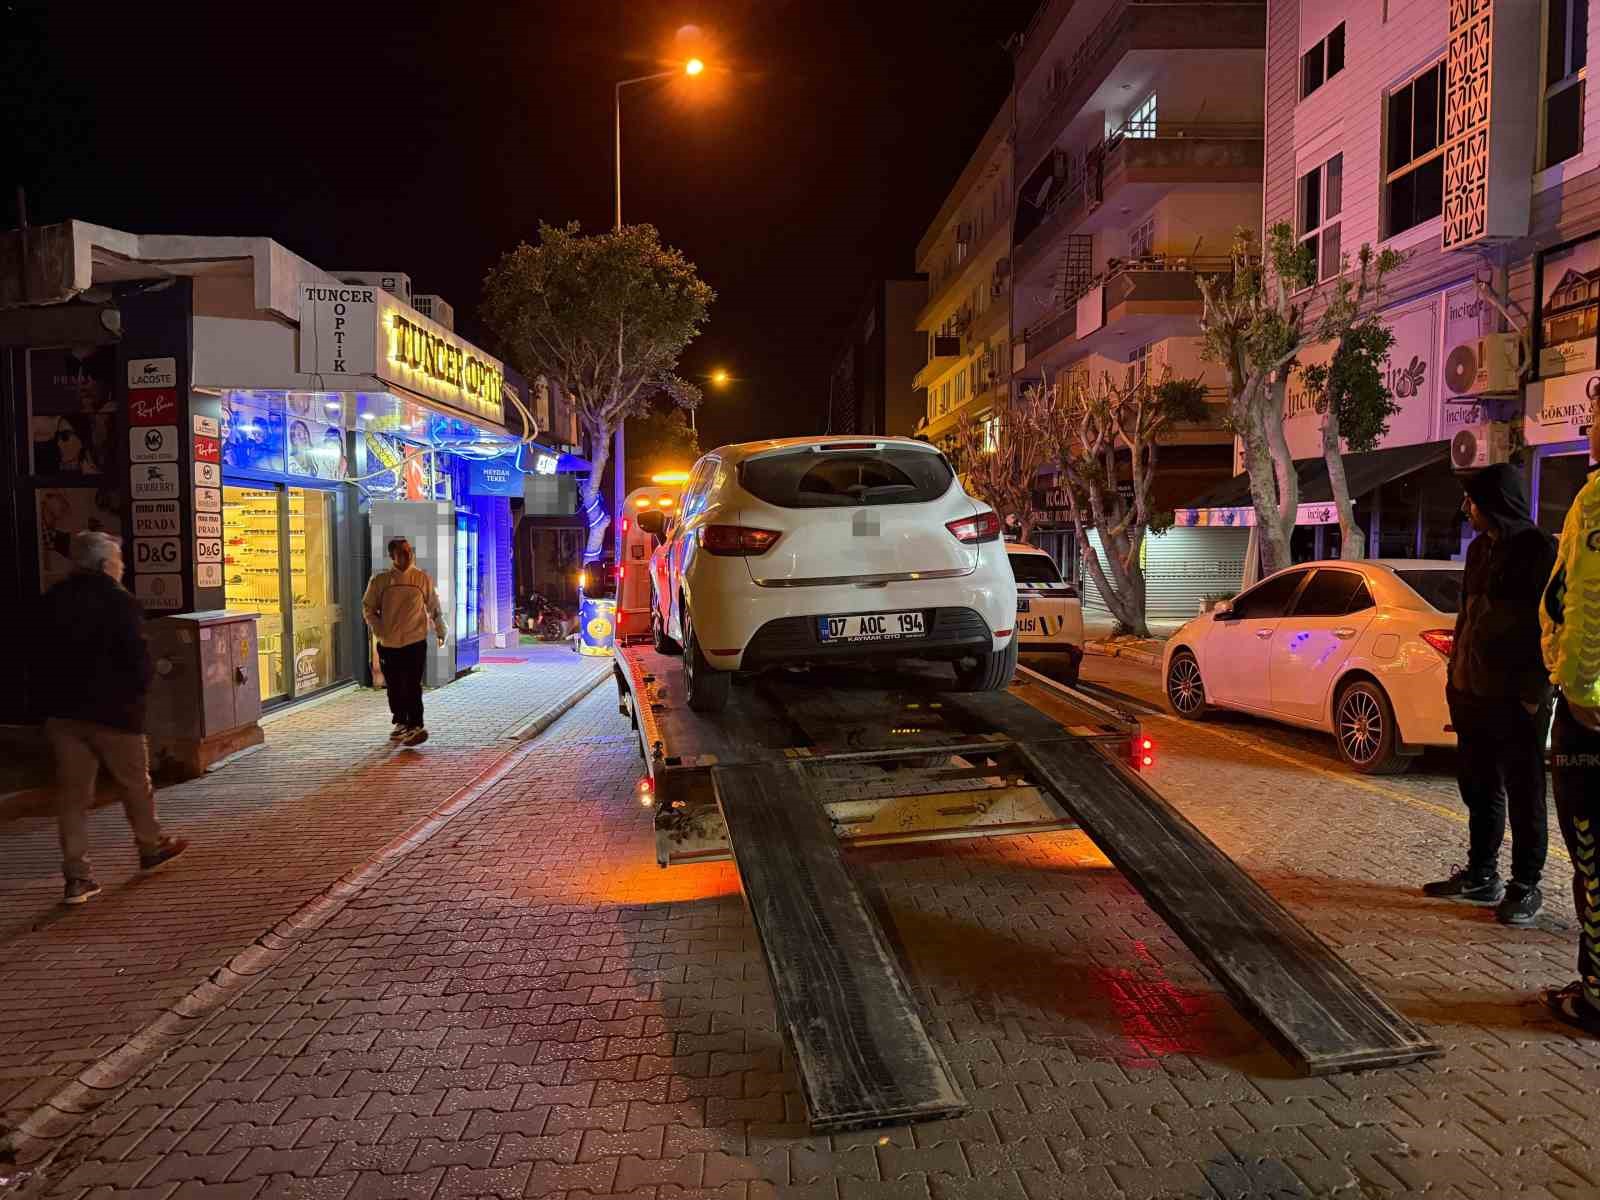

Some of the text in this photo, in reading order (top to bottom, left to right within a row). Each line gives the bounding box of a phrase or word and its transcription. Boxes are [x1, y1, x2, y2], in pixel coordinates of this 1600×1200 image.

[305, 288, 374, 303] TUNCER
[393, 314, 463, 389] TUNCER
[132, 374, 172, 384] LACOSTE
[137, 519, 176, 530] PRADA
[138, 542, 177, 562] D&G
[199, 542, 220, 556] D&G
[829, 619, 847, 637] 07
[898, 614, 923, 632] 194
